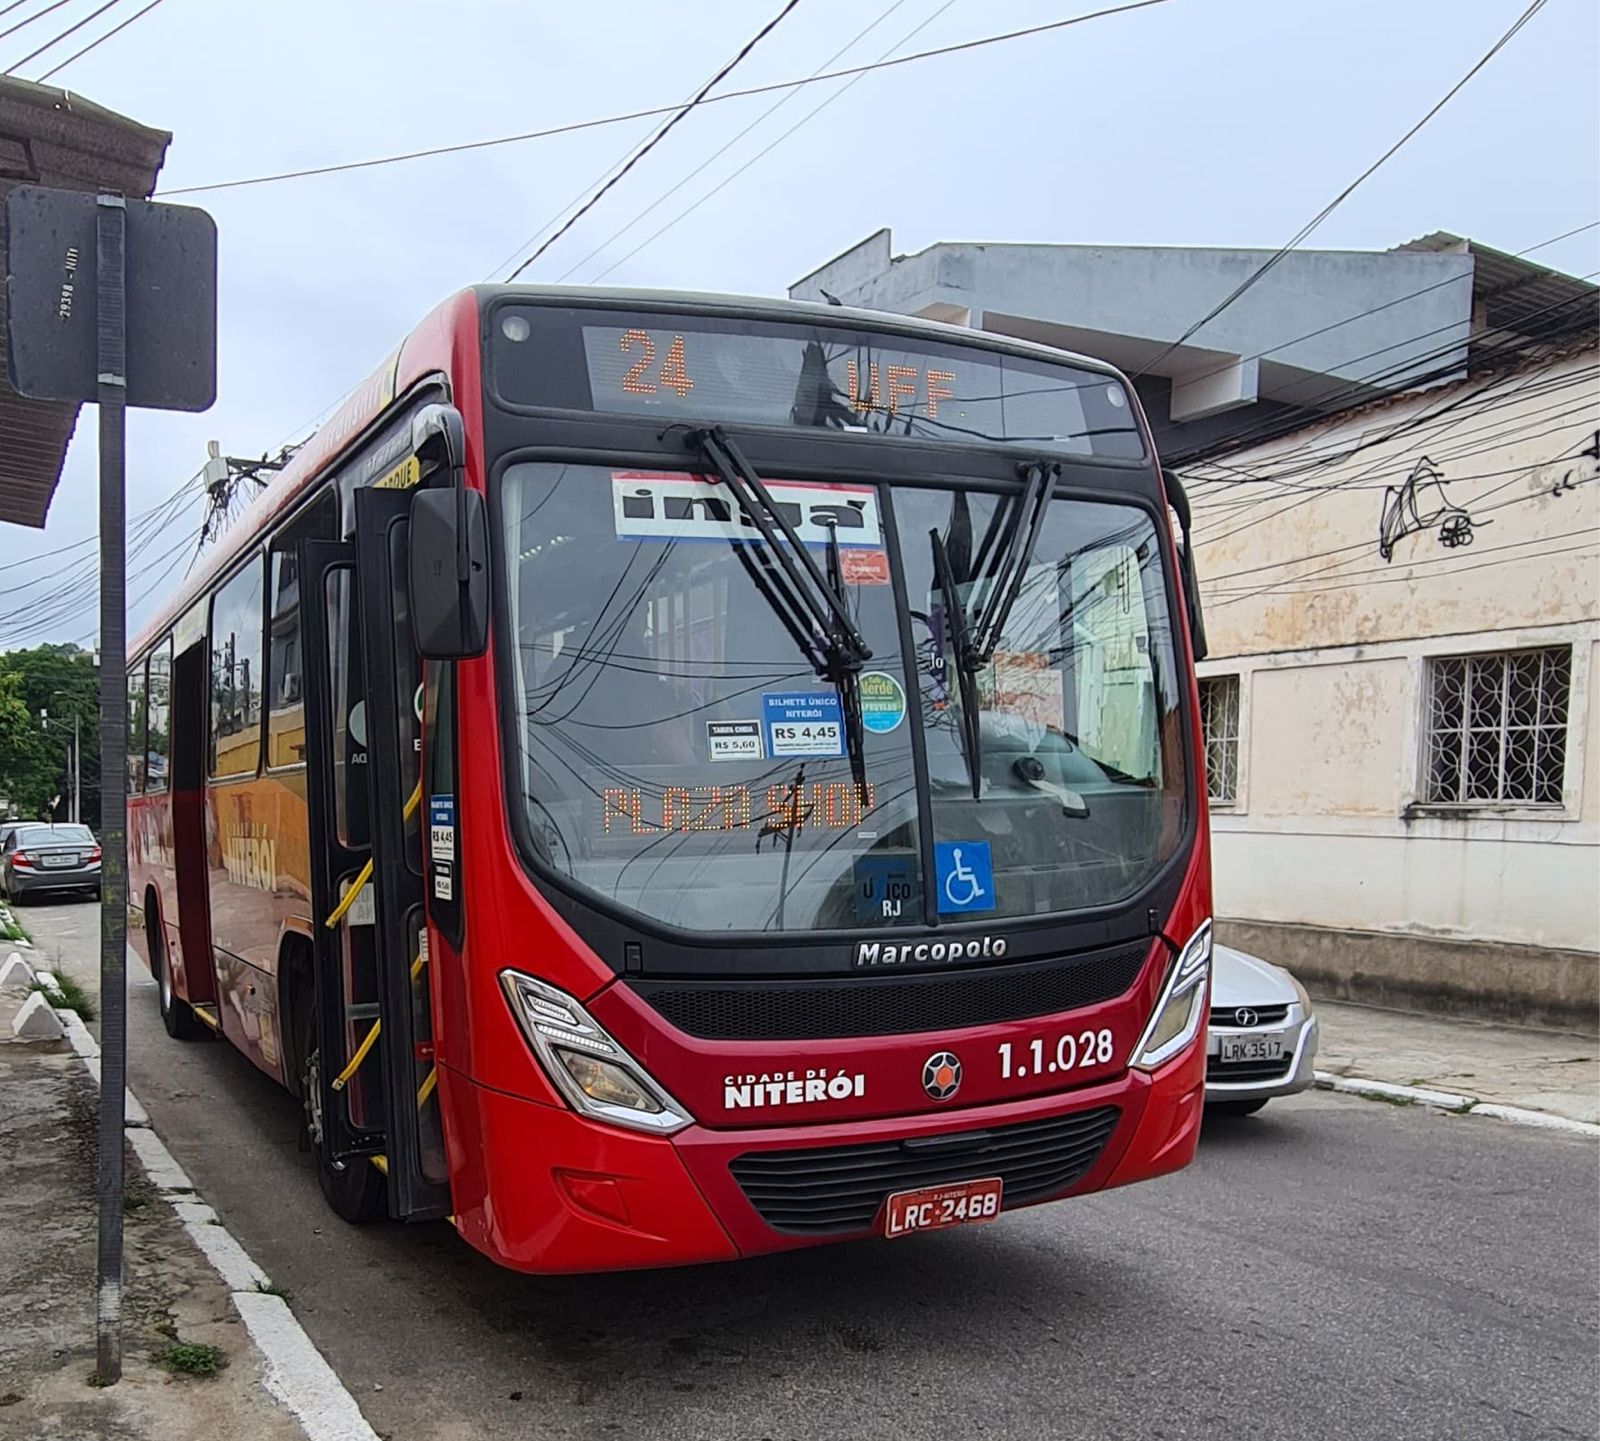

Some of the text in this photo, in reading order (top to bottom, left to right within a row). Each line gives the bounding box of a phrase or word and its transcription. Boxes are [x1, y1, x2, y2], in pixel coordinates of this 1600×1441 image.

[619, 329, 956, 418] 24 UFF
[768, 696, 837, 707] BILHETE ÚNICO
[801, 726, 837, 740] 4,45
[603, 786, 750, 833] PLAZA
[882, 899, 902, 917] RJ
[856, 936, 1008, 966] Marcopolo
[997, 1028, 1114, 1079] 1.1.028
[724, 1068, 827, 1085] CIDADE DE
[724, 1070, 865, 1109] NITERÓI
